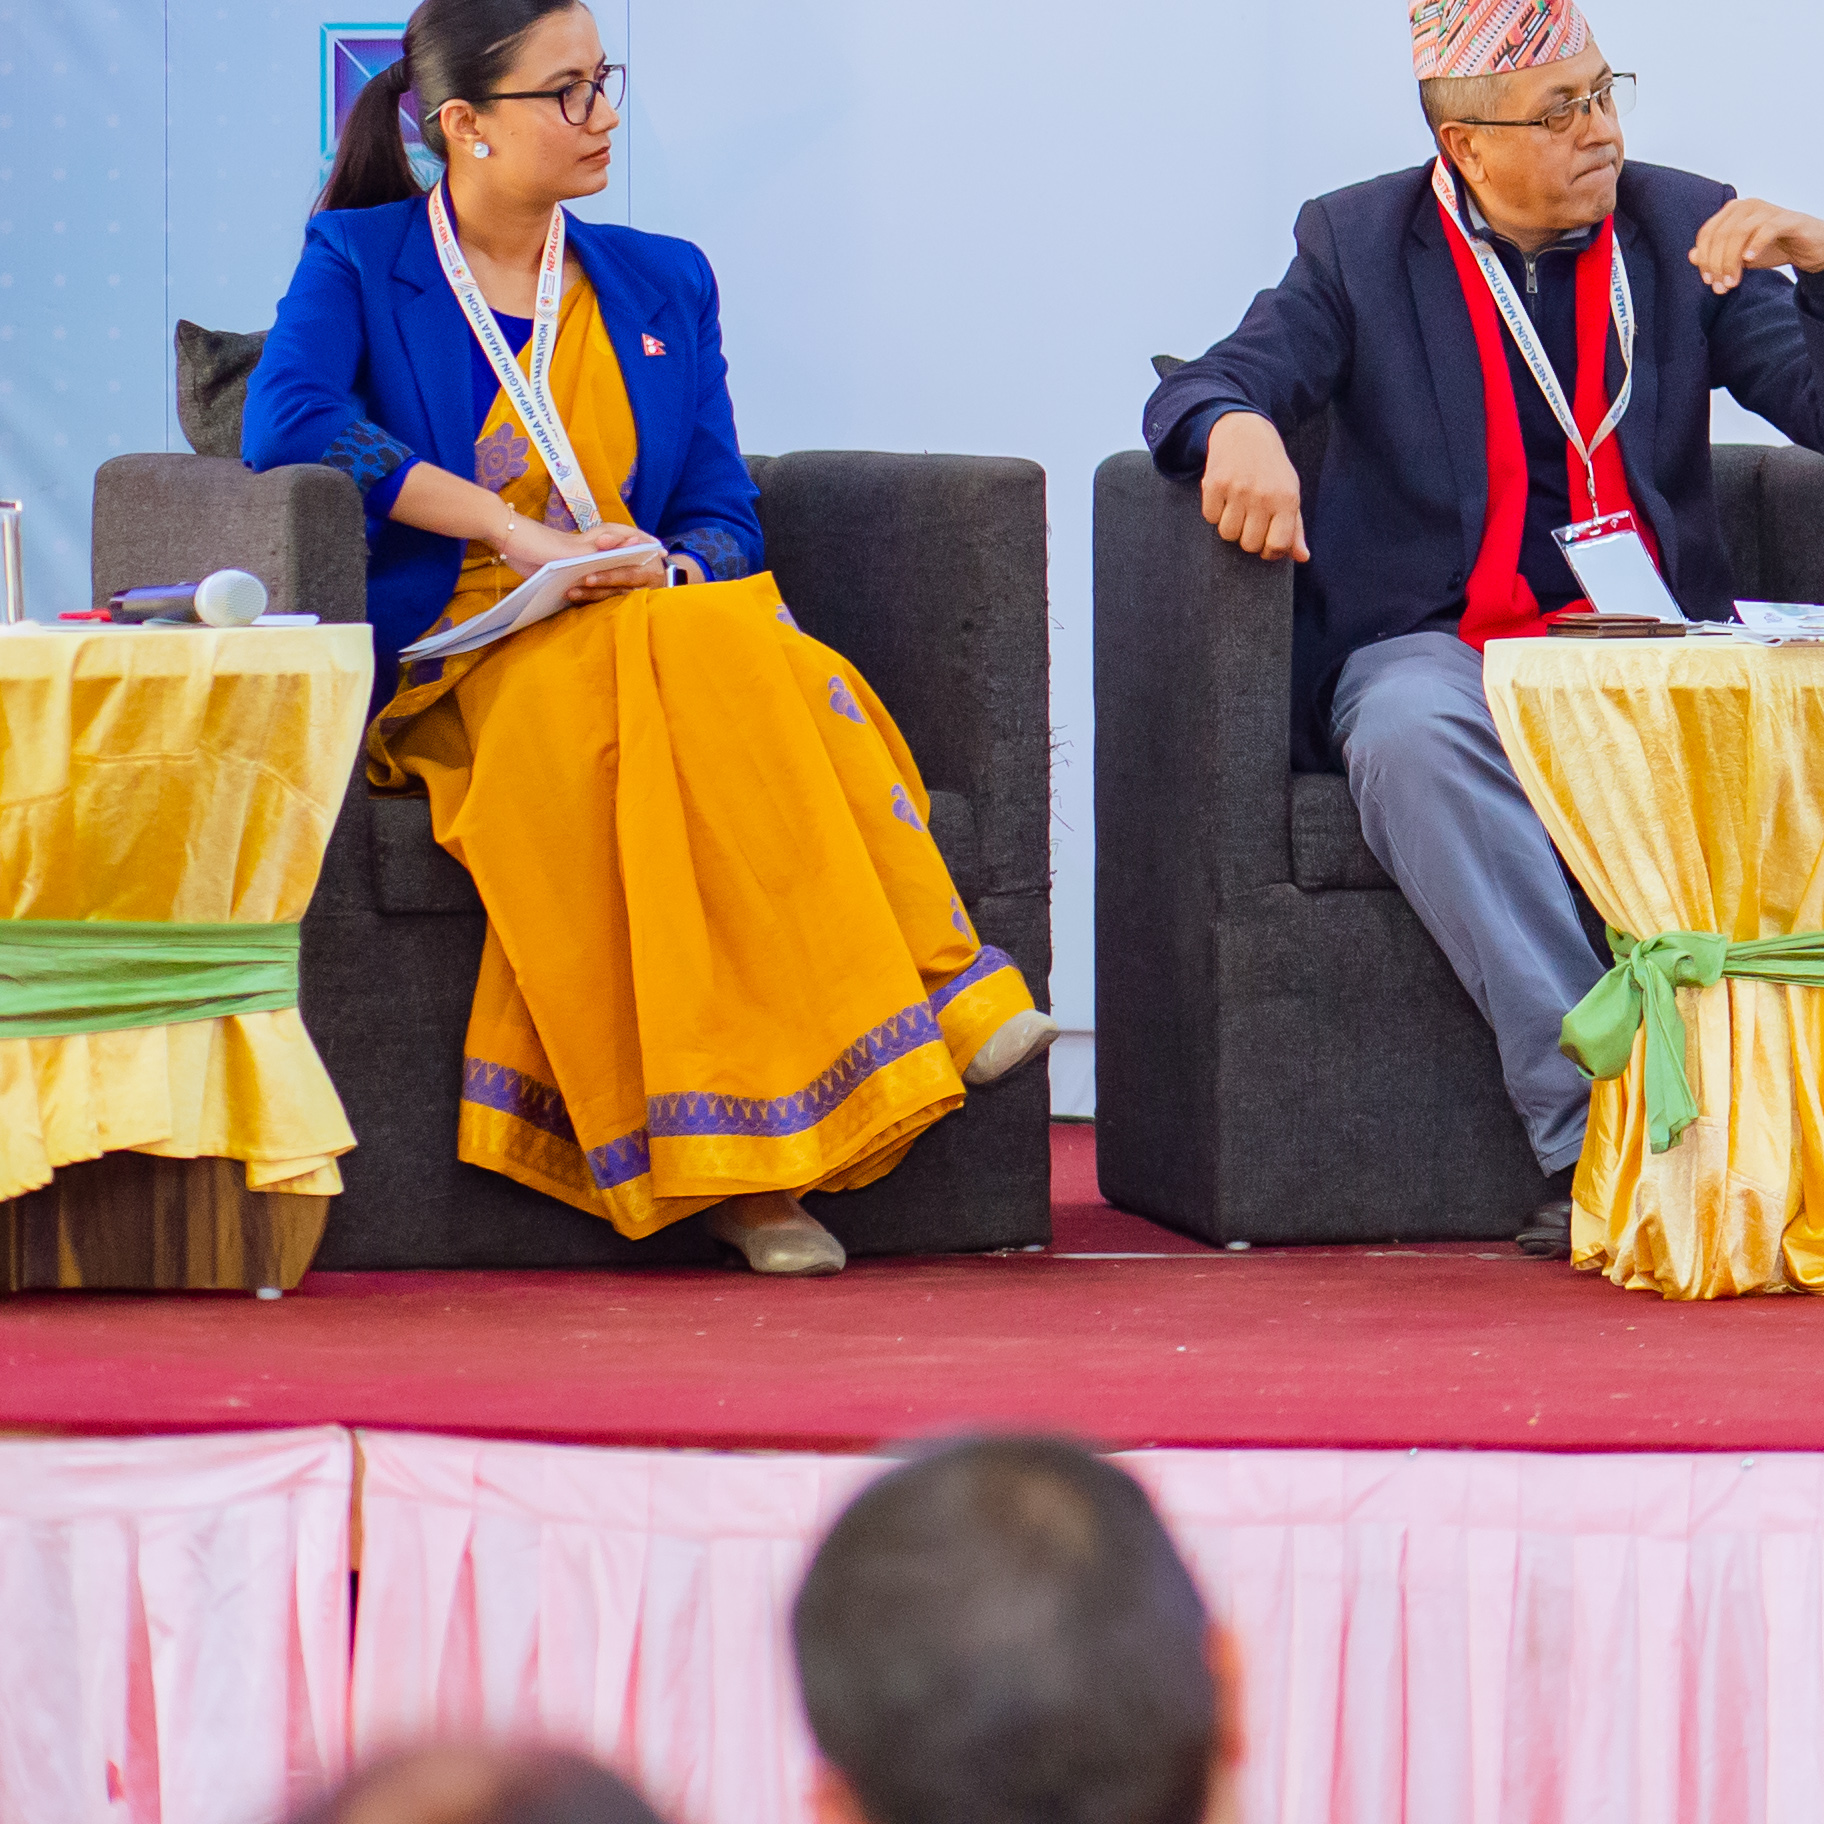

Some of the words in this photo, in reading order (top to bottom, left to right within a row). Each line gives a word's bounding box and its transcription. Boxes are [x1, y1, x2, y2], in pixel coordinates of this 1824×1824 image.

[1481, 256, 1514, 321] MARATHON
[465, 291, 503, 358] MARATHON
[1512, 317, 1545, 381] NEPALGUNJ
[501, 359, 537, 422] NEPALGUNJ
[532, 419, 559, 462] DHARA
